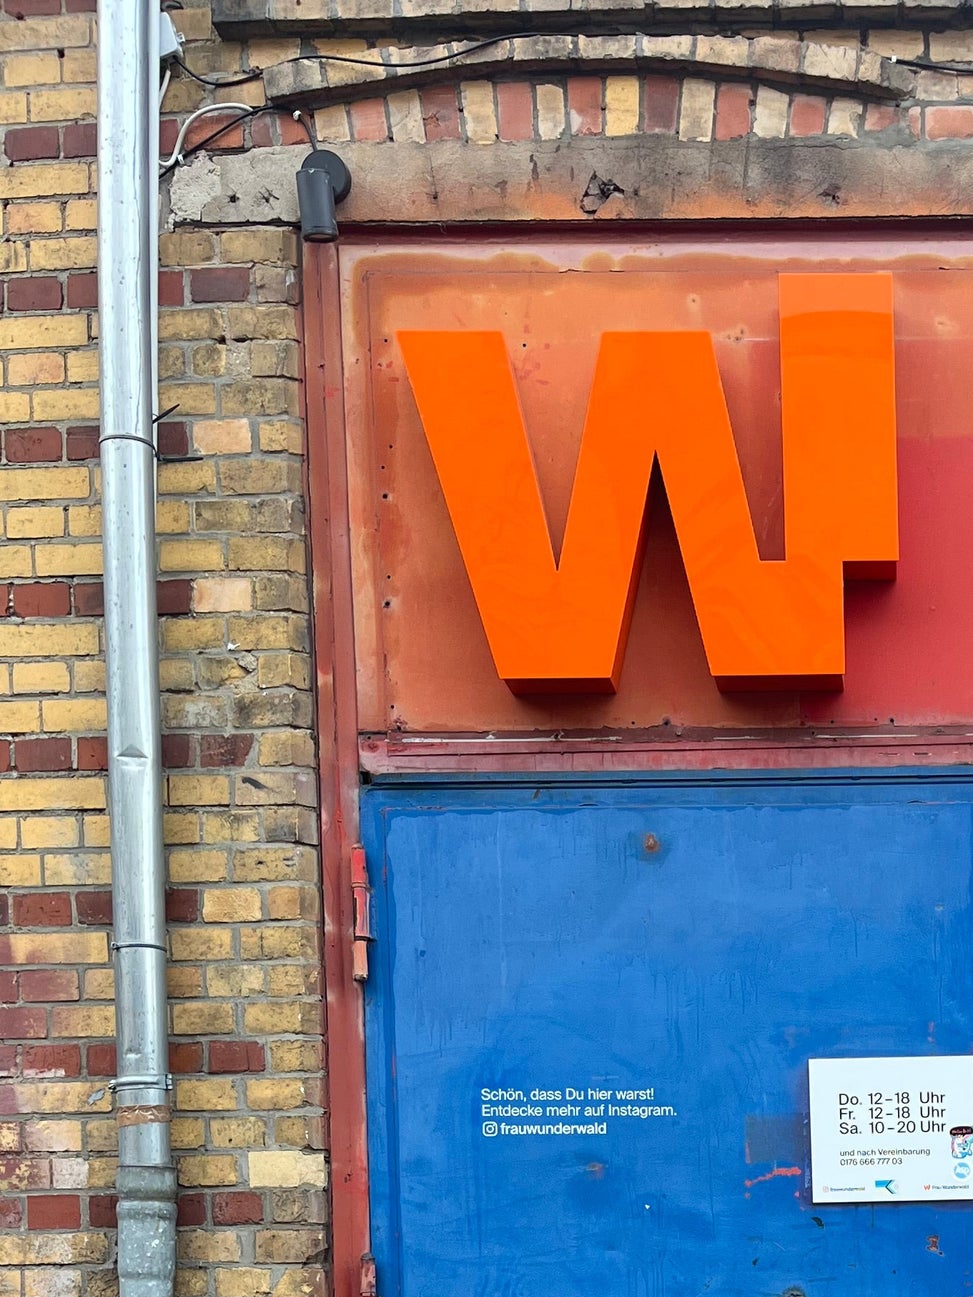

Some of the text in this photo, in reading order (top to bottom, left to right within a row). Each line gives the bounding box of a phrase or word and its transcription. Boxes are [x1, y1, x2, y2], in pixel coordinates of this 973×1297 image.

[396, 273, 899, 694] W
[480, 1087, 655, 1102] Schön, dass Du hier warst!
[838, 1093, 863, 1106] Do.
[919, 1091, 946, 1104] Uhr
[481, 1104, 678, 1119] Entdecke mehr auf Instagram.
[839, 1107, 856, 1120] Fr.
[919, 1106, 946, 1118] Uhr
[500, 1121, 607, 1135] frauwunderwald
[839, 1121, 862, 1135] Sa.
[920, 1120, 946, 1133] Uhr
[839, 1149, 855, 1157] und
[878, 1148, 931, 1156] Vereinbarung
[877, 1157, 890, 1165] 777
[891, 1157, 903, 1165] 03
